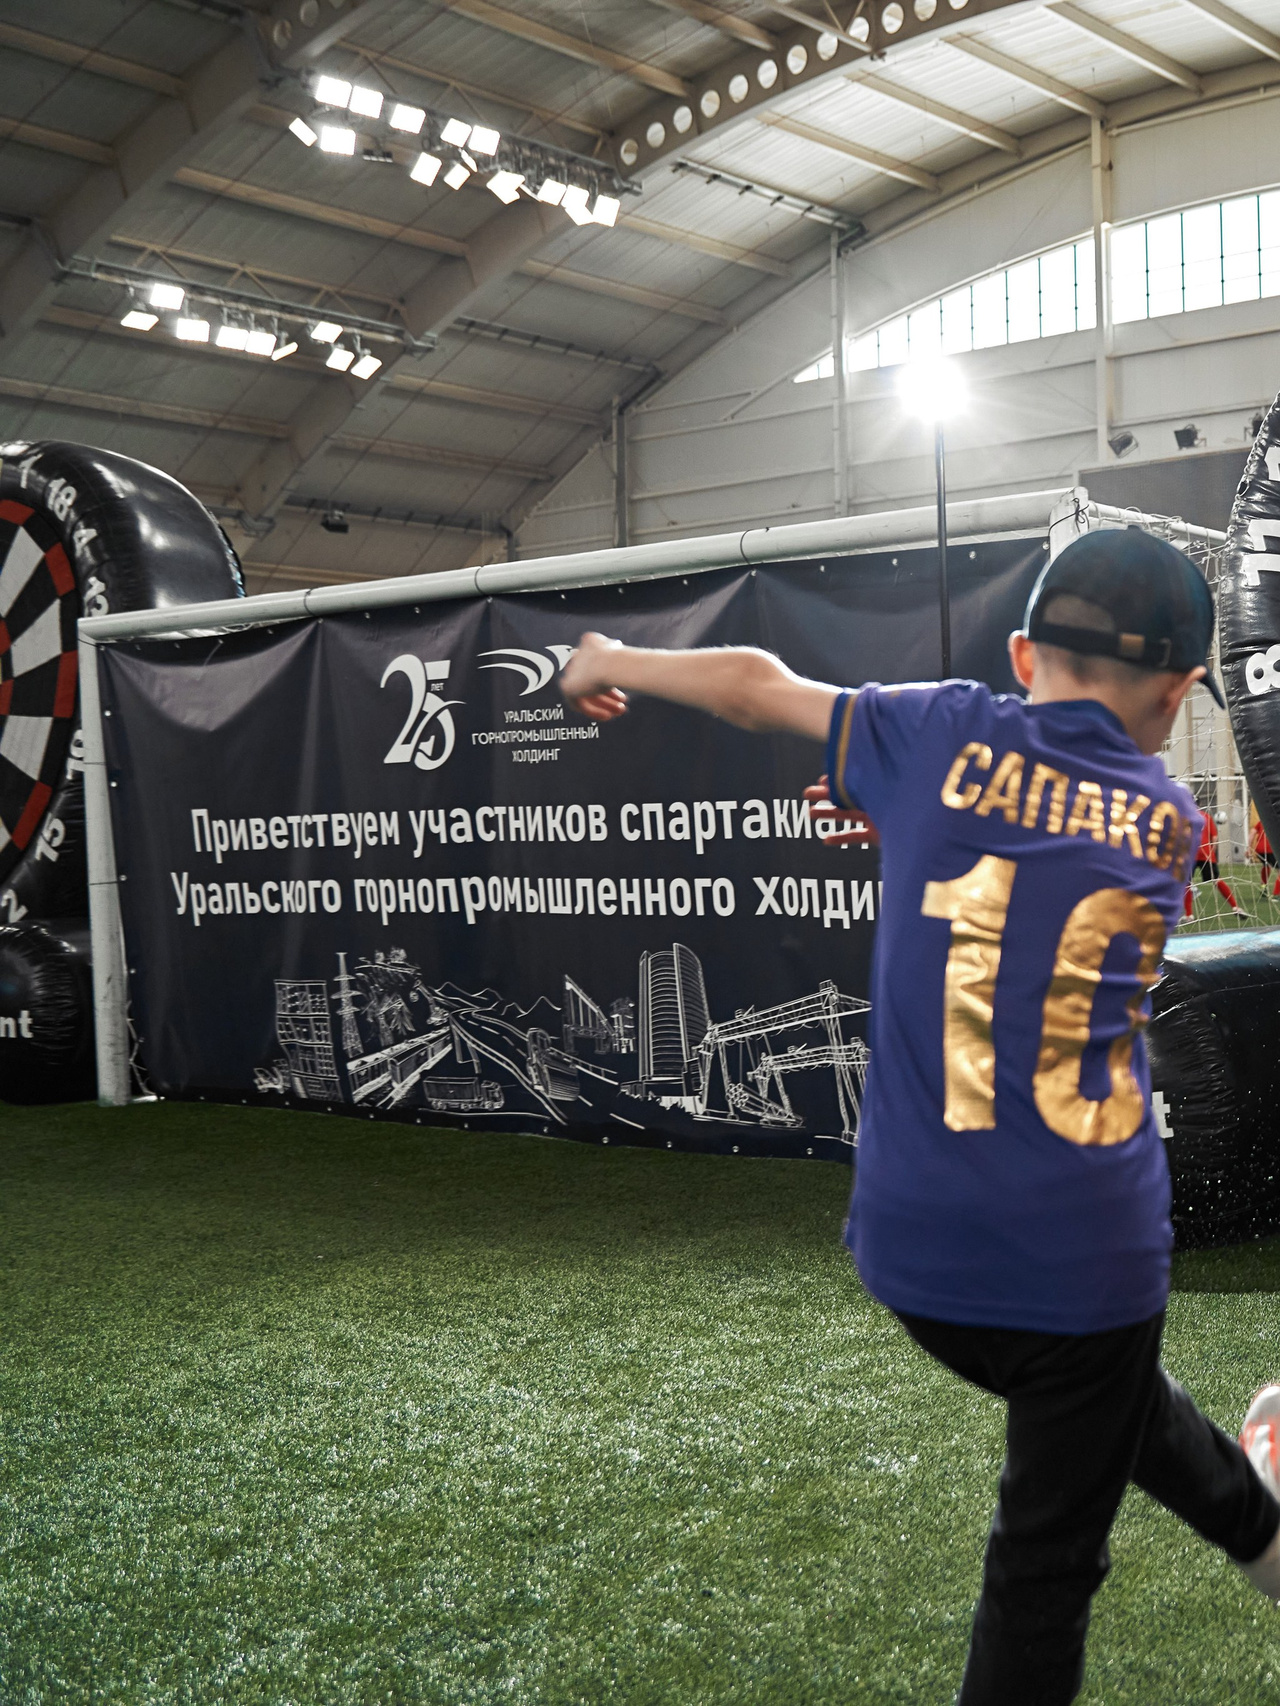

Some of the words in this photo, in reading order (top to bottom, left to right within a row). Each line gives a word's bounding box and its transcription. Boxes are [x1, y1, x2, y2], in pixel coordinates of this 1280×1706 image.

[380, 653, 466, 771] 25
[471, 722, 600, 746] ГОРНОПРОМЫШЛЕННЫЙ
[504, 703, 565, 724] УРАЛЬСКИЙ
[511, 748, 561, 764] ХОЛДИНГ
[191, 808, 400, 864] Приветствуем
[408, 804, 608, 858] участников
[170, 871, 342, 927] Уральского
[353, 875, 736, 926] горнопромышленного
[755, 876, 884, 930] холди
[921, 852, 1166, 1147] 10
